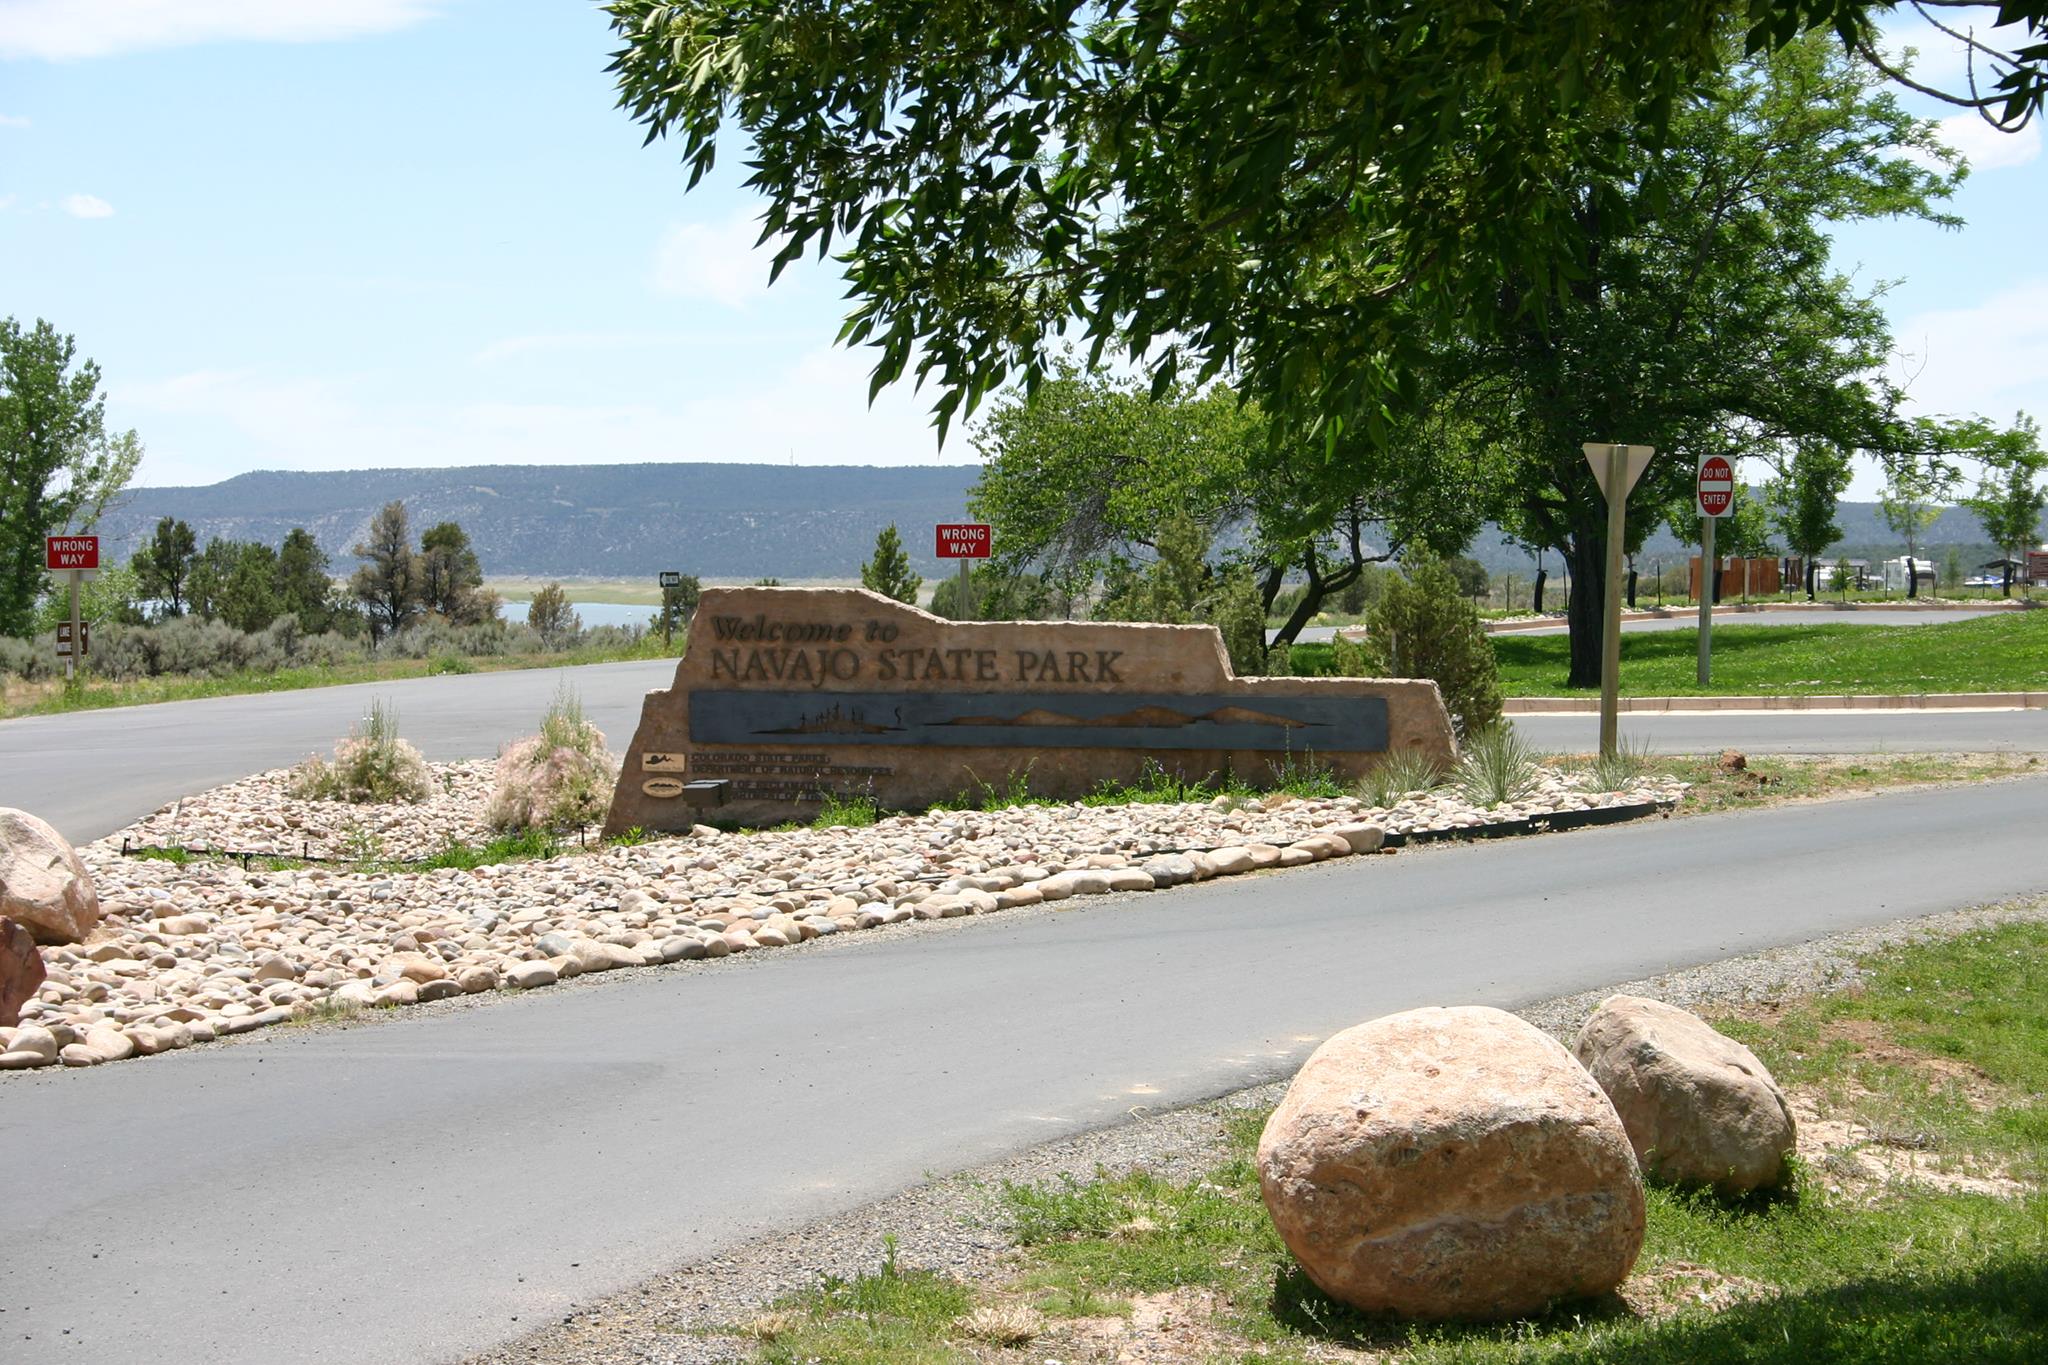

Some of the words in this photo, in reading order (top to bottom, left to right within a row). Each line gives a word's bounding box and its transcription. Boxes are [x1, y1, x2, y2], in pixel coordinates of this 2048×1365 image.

[1704, 468, 1713, 478] DO
[1715, 468, 1729, 478] NOT
[1704, 494, 1726, 505] ENTER
[942, 528, 985, 540] WRONG
[52, 540, 93, 552] WRONG
[950, 543, 976, 554] WAY
[60, 554, 85, 565] WAY
[710, 613, 852, 643] Welcome
[865, 618, 899, 643] to
[709, 648, 860, 688] NAVAJO
[878, 648, 999, 682] STATE
[1015, 648, 1124, 683] PARK
[691, 753, 750, 763] COLORADO
[755, 753, 786, 763] STATE
[693, 765, 757, 775] DEPARTMENT
[761, 765, 775, 775] OF
[780, 766, 824, 775] NATURAL
